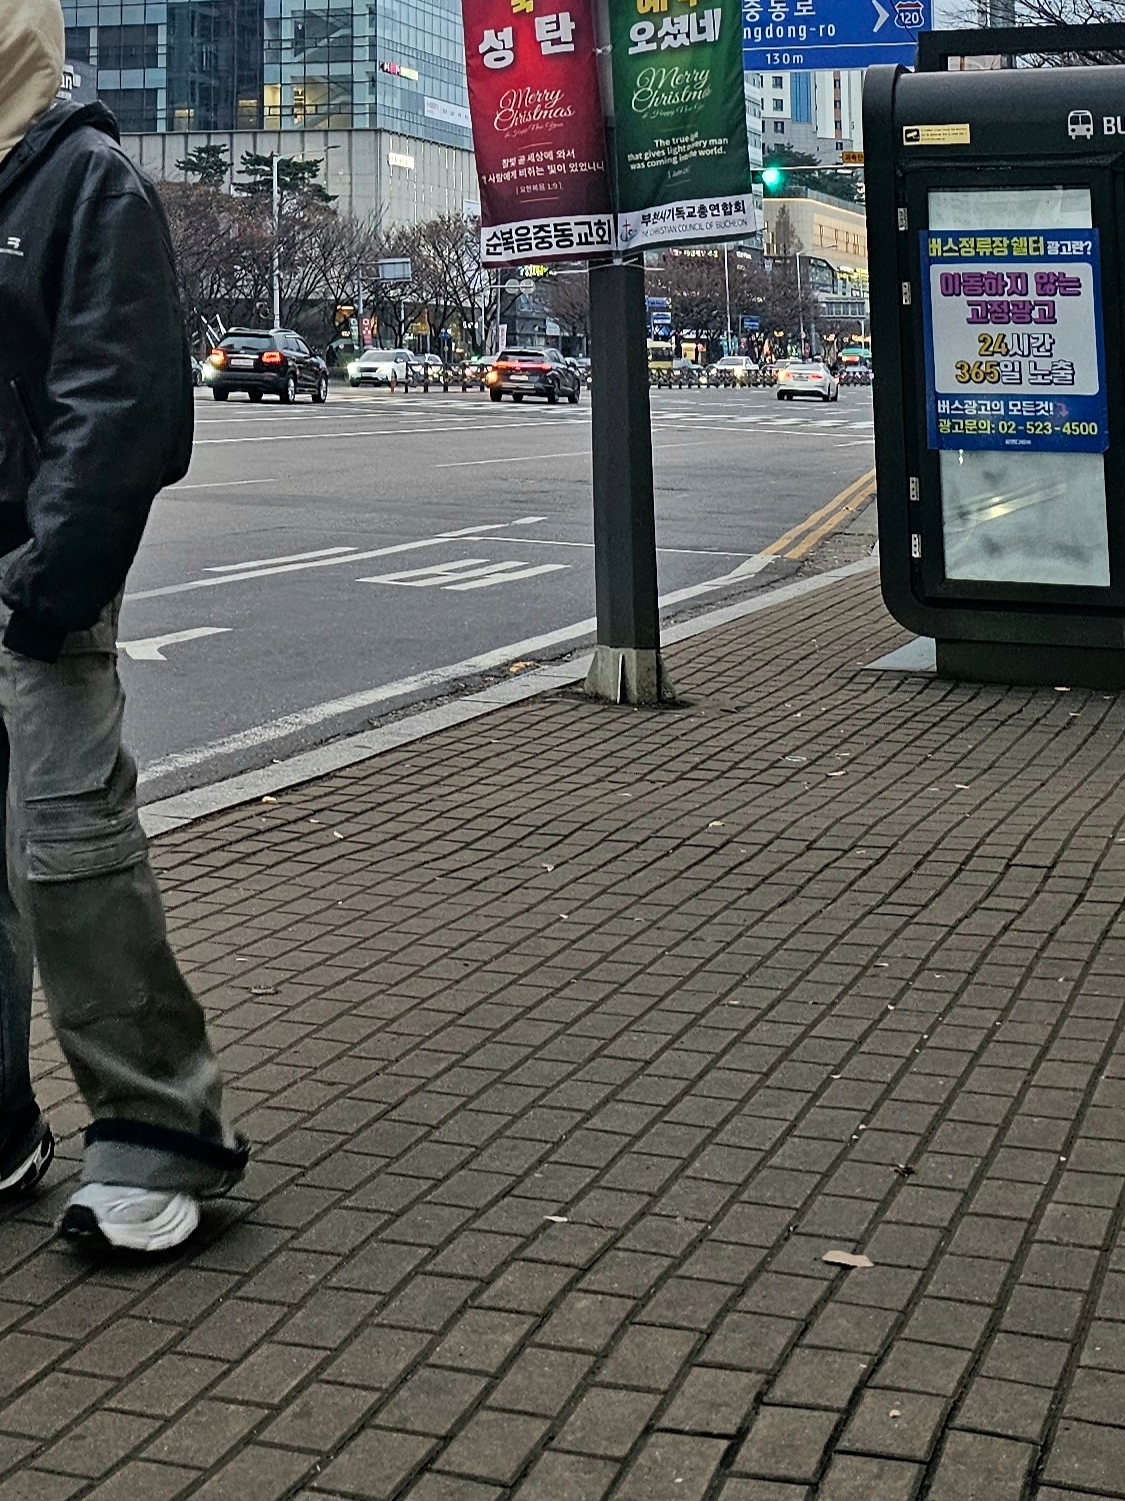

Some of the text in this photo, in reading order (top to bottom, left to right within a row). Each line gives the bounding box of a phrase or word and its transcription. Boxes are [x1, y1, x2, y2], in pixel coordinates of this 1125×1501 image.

[900, 11, 919, 25] 120
[628, 7, 722, 55] 오셨네
[765, 53, 804, 65] 130m
[636, 67, 710, 90] Merry
[499, 87, 564, 113] Merry
[493, 103, 576, 132] Christmas
[644, 148, 666, 161] gives
[709, 137, 729, 146] man
[654, 138, 670, 148] The
[672, 135, 689, 145] true
[555, 148, 576, 160] 와서
[630, 160, 646, 170] was
[647, 155, 678, 166] coming
[698, 146, 727, 157] world.
[518, 165, 545, 179] 비취는
[546, 162, 567, 176] 빛이
[641, 200, 747, 227] 부천시기독교총연합회
[678, 222, 705, 233] COUNCIL
[705, 221, 714, 231] OF
[715, 218, 748, 229] BUCHEON
[485, 218, 612, 256] 순복음중동교회
[928, 236, 1092, 257] 버스정류장 쉘터 광고란?
[939, 271, 1082, 297] 이동하지 않는
[966, 300, 1058, 325] 고정광고
[978, 333, 1056, 357] 24시간
[955, 360, 1075, 385] 365일 노출
[937, 400, 1054, 416] 버스광고의 모든것!
[938, 418, 996, 435] 광고문의:
